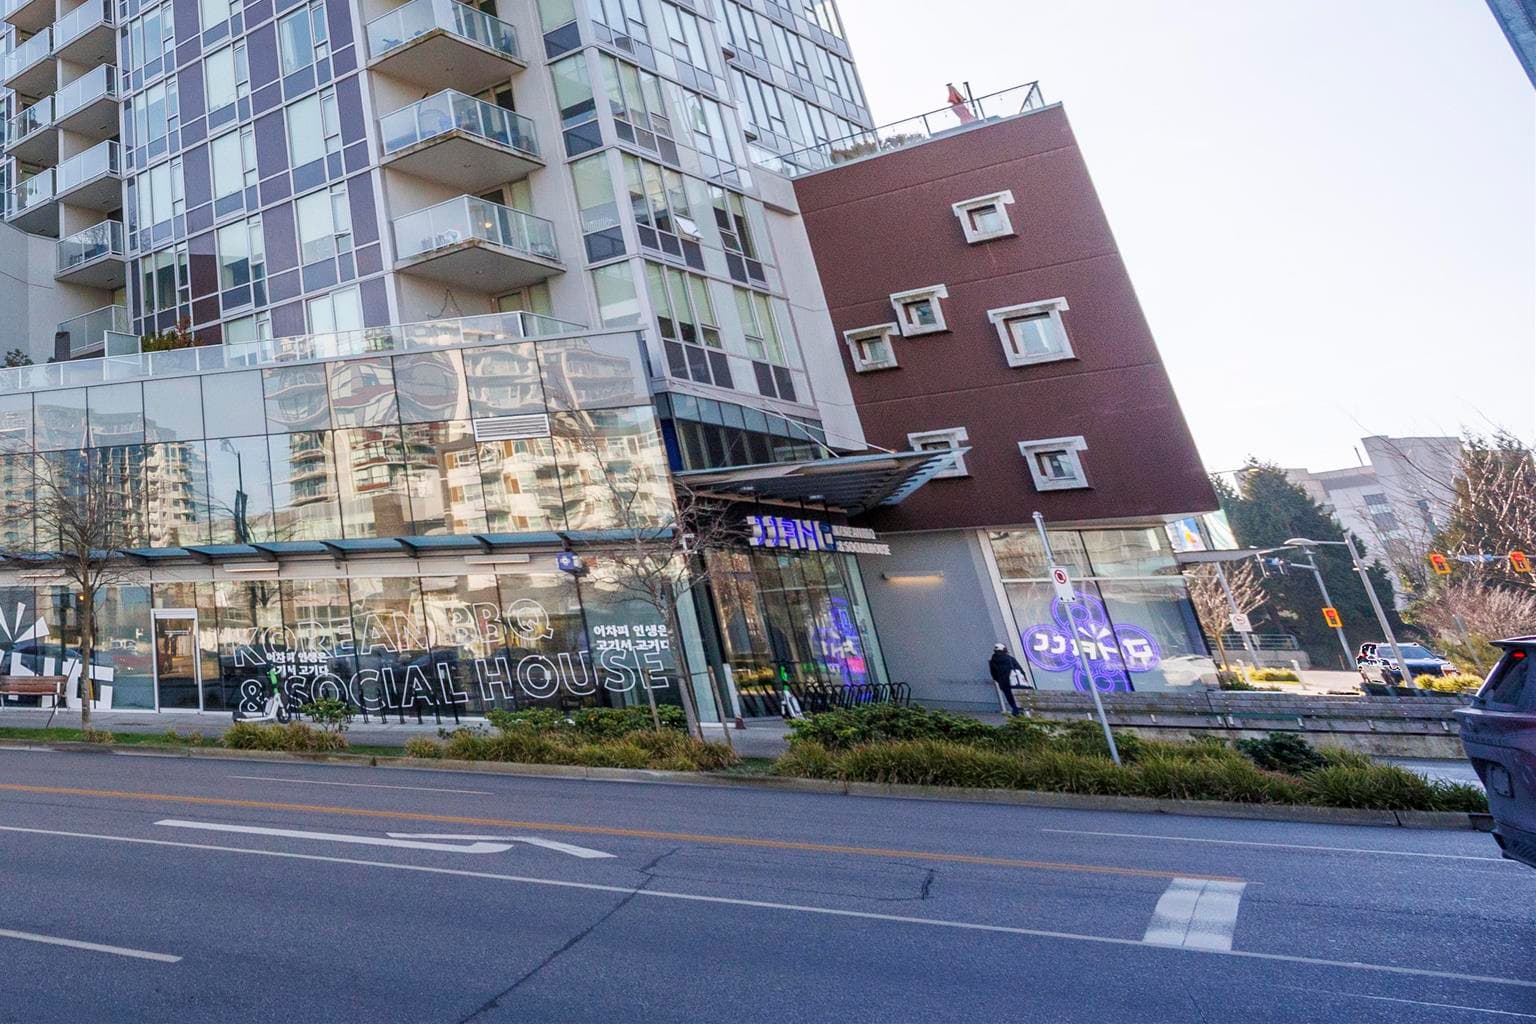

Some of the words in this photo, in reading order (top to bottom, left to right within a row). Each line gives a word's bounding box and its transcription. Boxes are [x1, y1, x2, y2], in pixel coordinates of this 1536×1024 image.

[232, 608, 431, 667] KOREAN
[443, 598, 554, 646] BBQ
[593, 624, 630, 637] 어차피
[632, 624, 668, 637] 인생은
[596, 639, 633, 651] 고기서
[284, 662, 469, 711] SOCIAL
[475, 646, 670, 702] HOUSE
